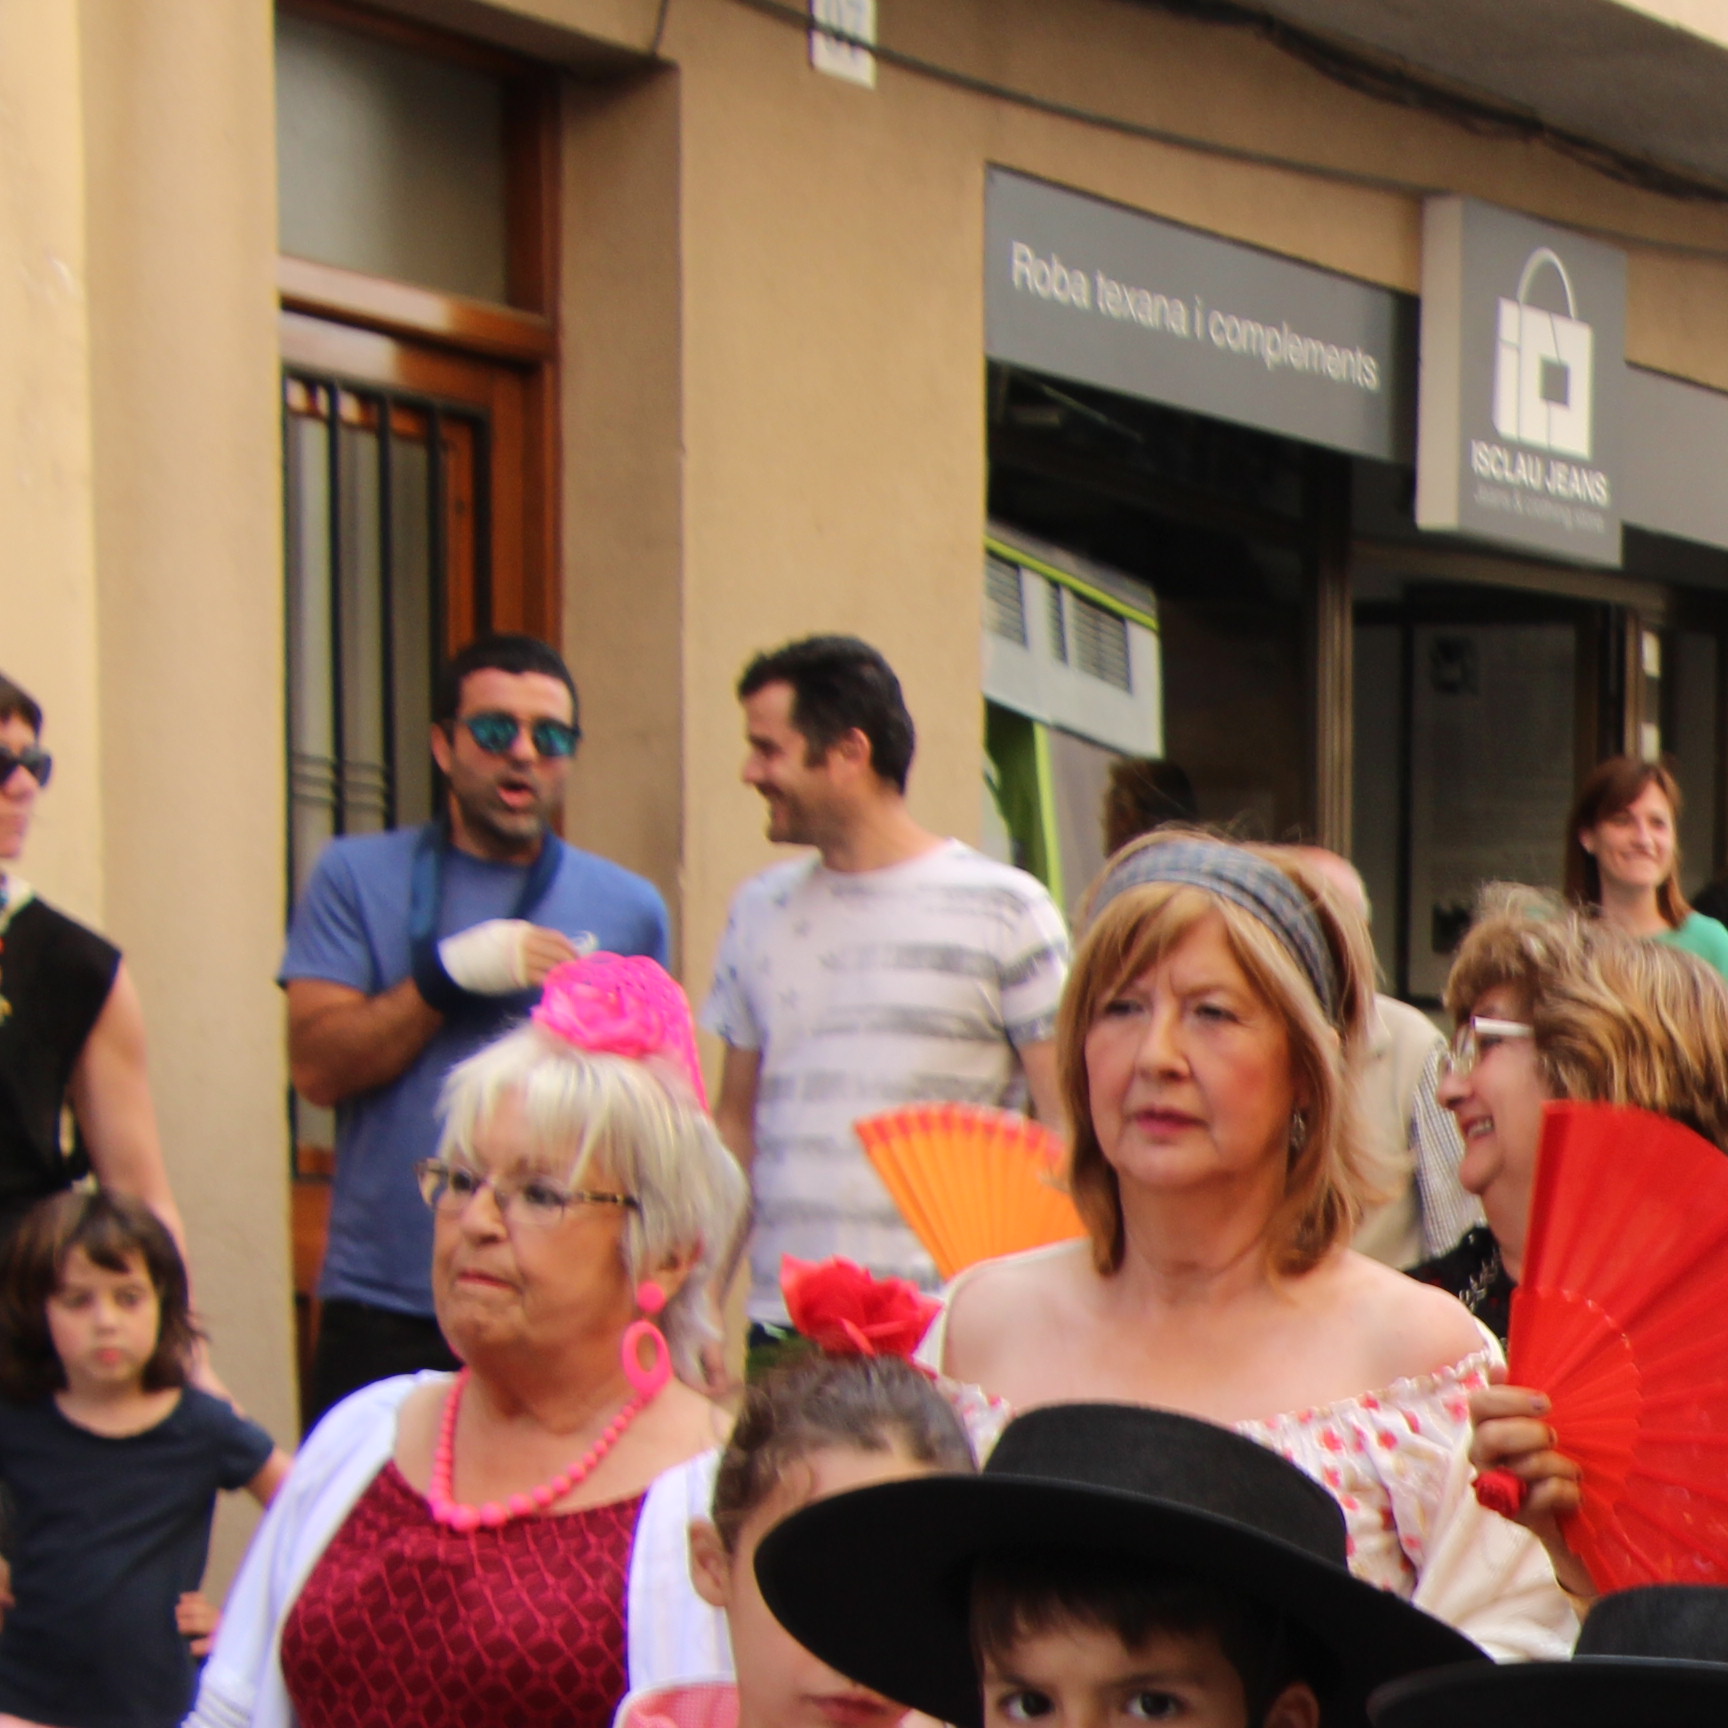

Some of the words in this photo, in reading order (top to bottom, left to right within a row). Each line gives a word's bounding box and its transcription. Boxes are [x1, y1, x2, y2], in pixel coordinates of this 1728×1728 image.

[1011, 241, 1090, 311] Roba
[1096, 269, 1190, 338] texana
[1194, 294, 1203, 340] i
[1209, 309, 1381, 392] complements
[1471, 438, 1542, 491] ISCLAU
[1545, 459, 1611, 507] JEANS
